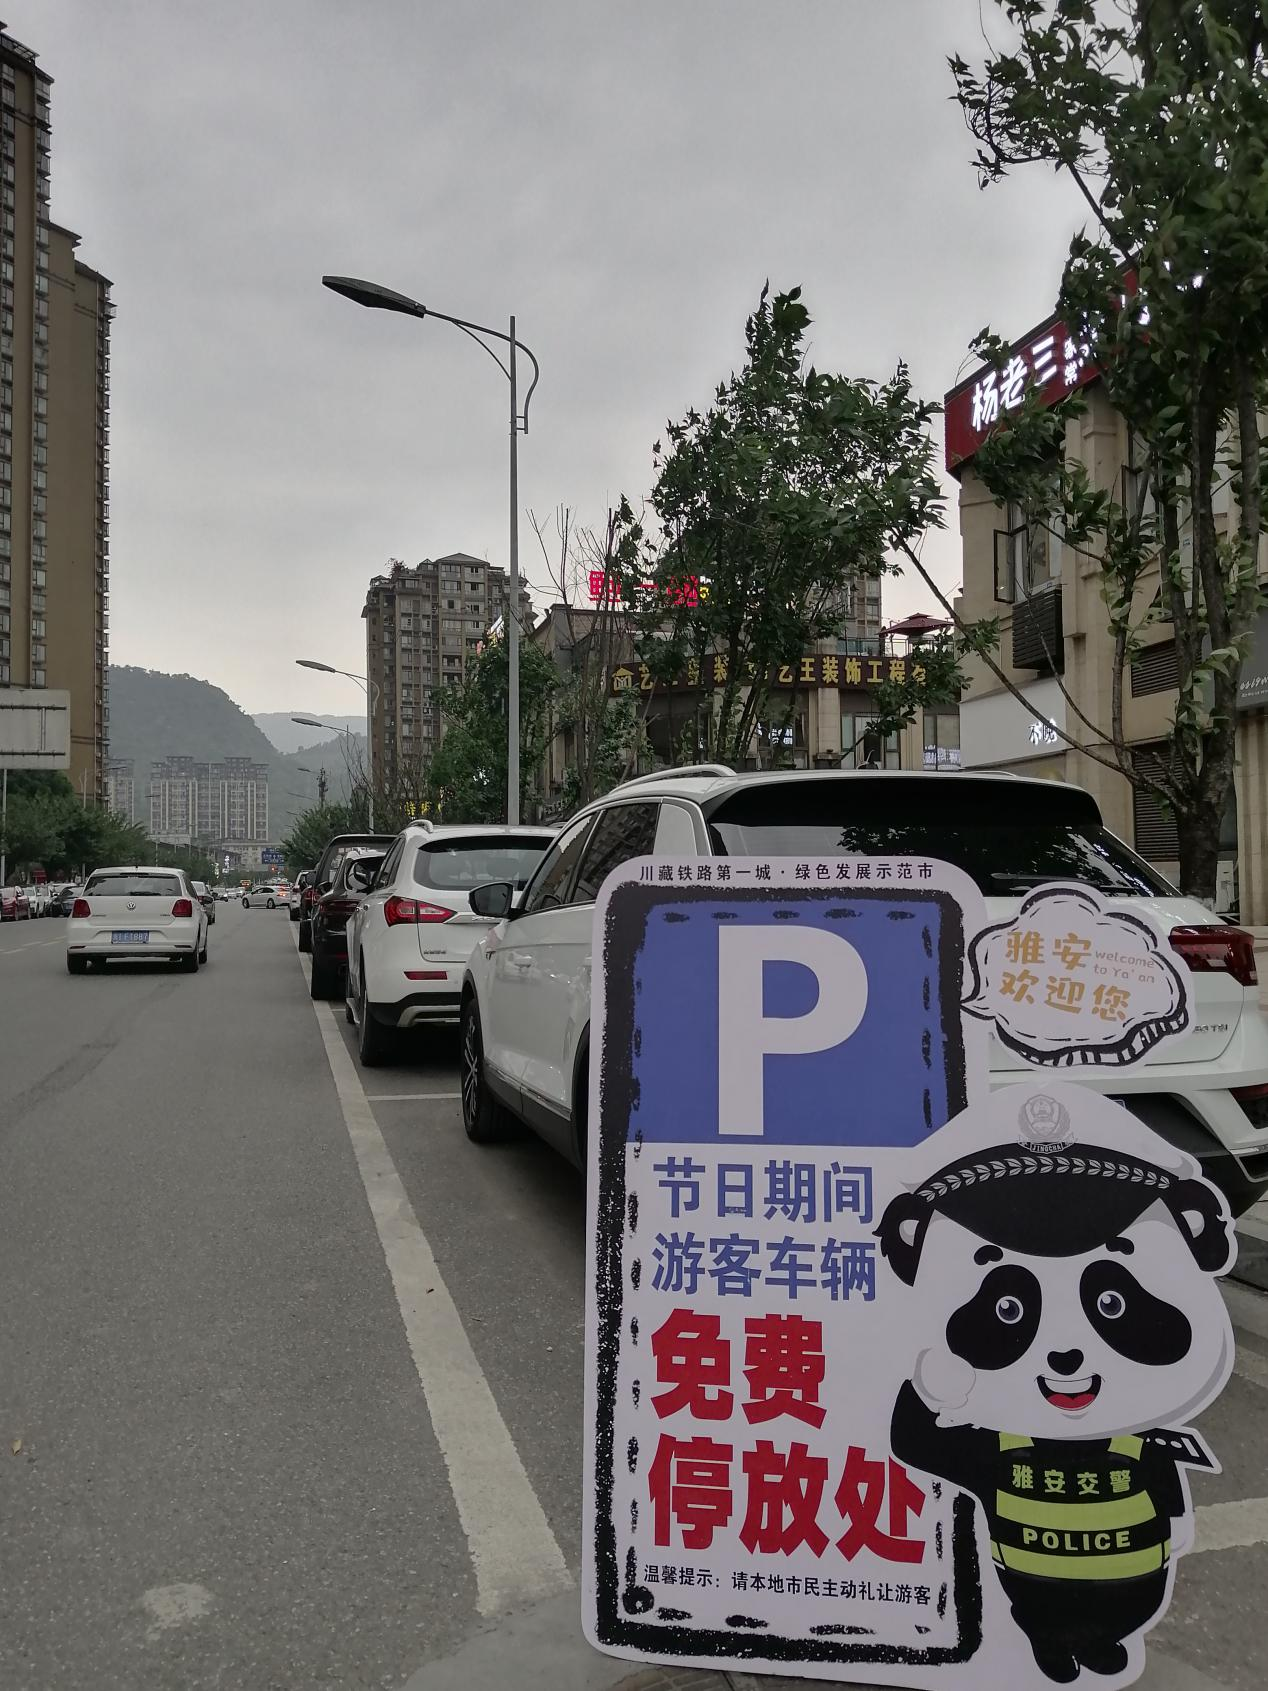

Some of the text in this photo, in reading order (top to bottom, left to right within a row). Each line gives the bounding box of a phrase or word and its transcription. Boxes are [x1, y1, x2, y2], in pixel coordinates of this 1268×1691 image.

[972, 335, 1057, 432] 杨老三
[1005, 930, 1092, 971] 雅安
[1094, 963, 1106, 975] to
[1095, 950, 1155, 969] welcome
[999, 969, 1131, 1022] 欢迎您
[718, 925, 868, 1136] P
[653, 1156, 873, 1224] 节日期间
[651, 1231, 876, 1301] 游客车辆
[650, 1308, 826, 1430] 免费
[648, 1433, 926, 1564] 停放处
[1012, 1464, 1131, 1496] 雅安交警
[1022, 1527, 1131, 1551] POLICE
